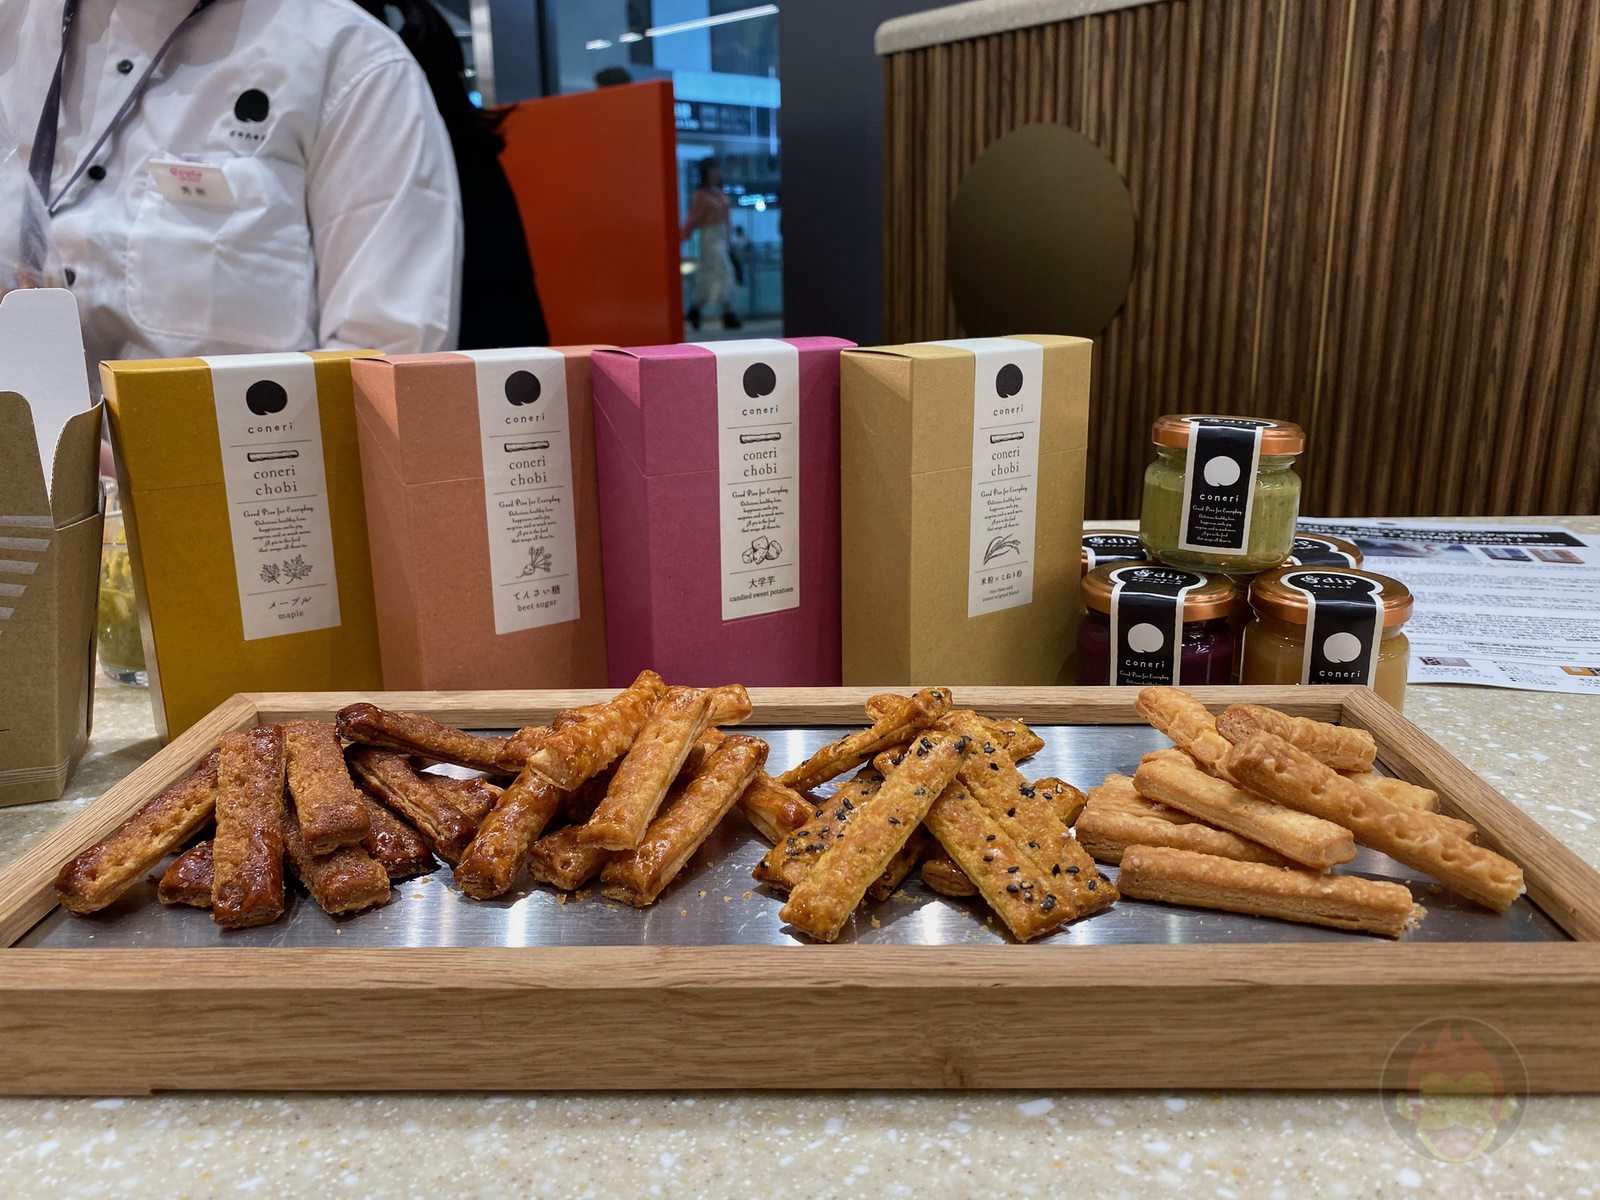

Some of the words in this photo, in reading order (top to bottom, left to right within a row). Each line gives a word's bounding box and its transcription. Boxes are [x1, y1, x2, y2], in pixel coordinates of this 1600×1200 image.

[742, 405, 778, 416] coneri
[993, 404, 1024, 416] coneri
[505, 413, 544, 424] coneri
[248, 422, 293, 434] coneri
[744, 447, 776, 461] coneri
[992, 446, 1020, 460] coneri
[509, 456, 546, 470] coneri
[992, 462, 1019, 476] chobi
[254, 464, 296, 479] coneri
[744, 463, 777, 477] chobi
[510, 472, 547, 486] chobi
[256, 481, 298, 496] chobi
[1200, 494, 1239, 502] coneri
[748, 576, 775, 589] 大学芋
[770, 587, 794, 597] potatoes
[518, 604, 535, 612] beet
[536, 600, 557, 608] sugar
[278, 610, 304, 620] maple
[1126, 660, 1165, 668] coneri
[1320, 670, 1360, 678] coneri
